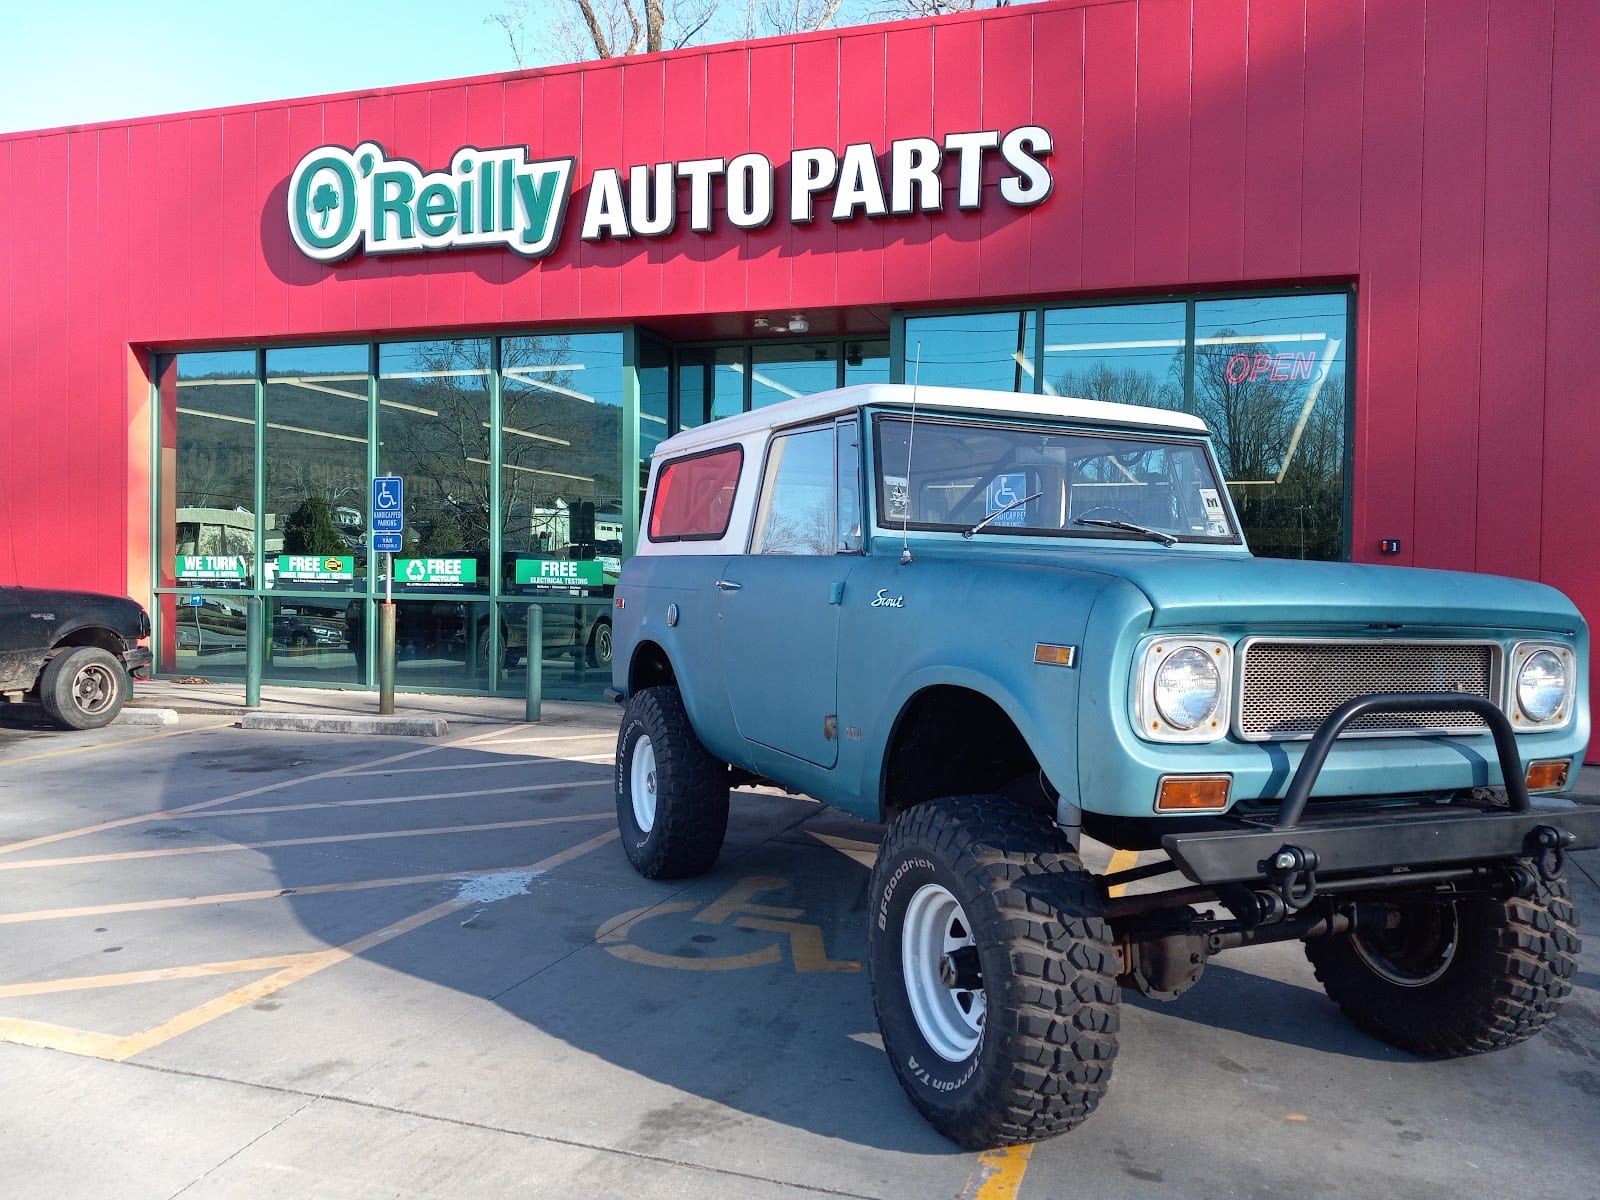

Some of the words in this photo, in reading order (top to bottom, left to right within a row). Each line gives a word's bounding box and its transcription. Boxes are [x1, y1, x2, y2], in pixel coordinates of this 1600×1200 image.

[293, 148, 563, 251] O'Reilly
[580, 153, 773, 240] AUTO
[791, 126, 1054, 223] PARTS
[1225, 351, 1316, 384] OPEN
[373, 511, 401, 519] HANDICAPPED
[377, 519, 398, 527] PARKING
[183, 555, 203, 570] WE
[205, 555, 237, 571] TURN
[288, 556, 321, 572] FREE
[427, 559, 462, 575] FREE
[541, 561, 578, 577] FREE
[530, 576, 563, 585] ELECTRICAL
[564, 577, 588, 585] TESTING
[870, 588, 905, 608] Scout
[878, 857, 936, 932] BFGoodrich
